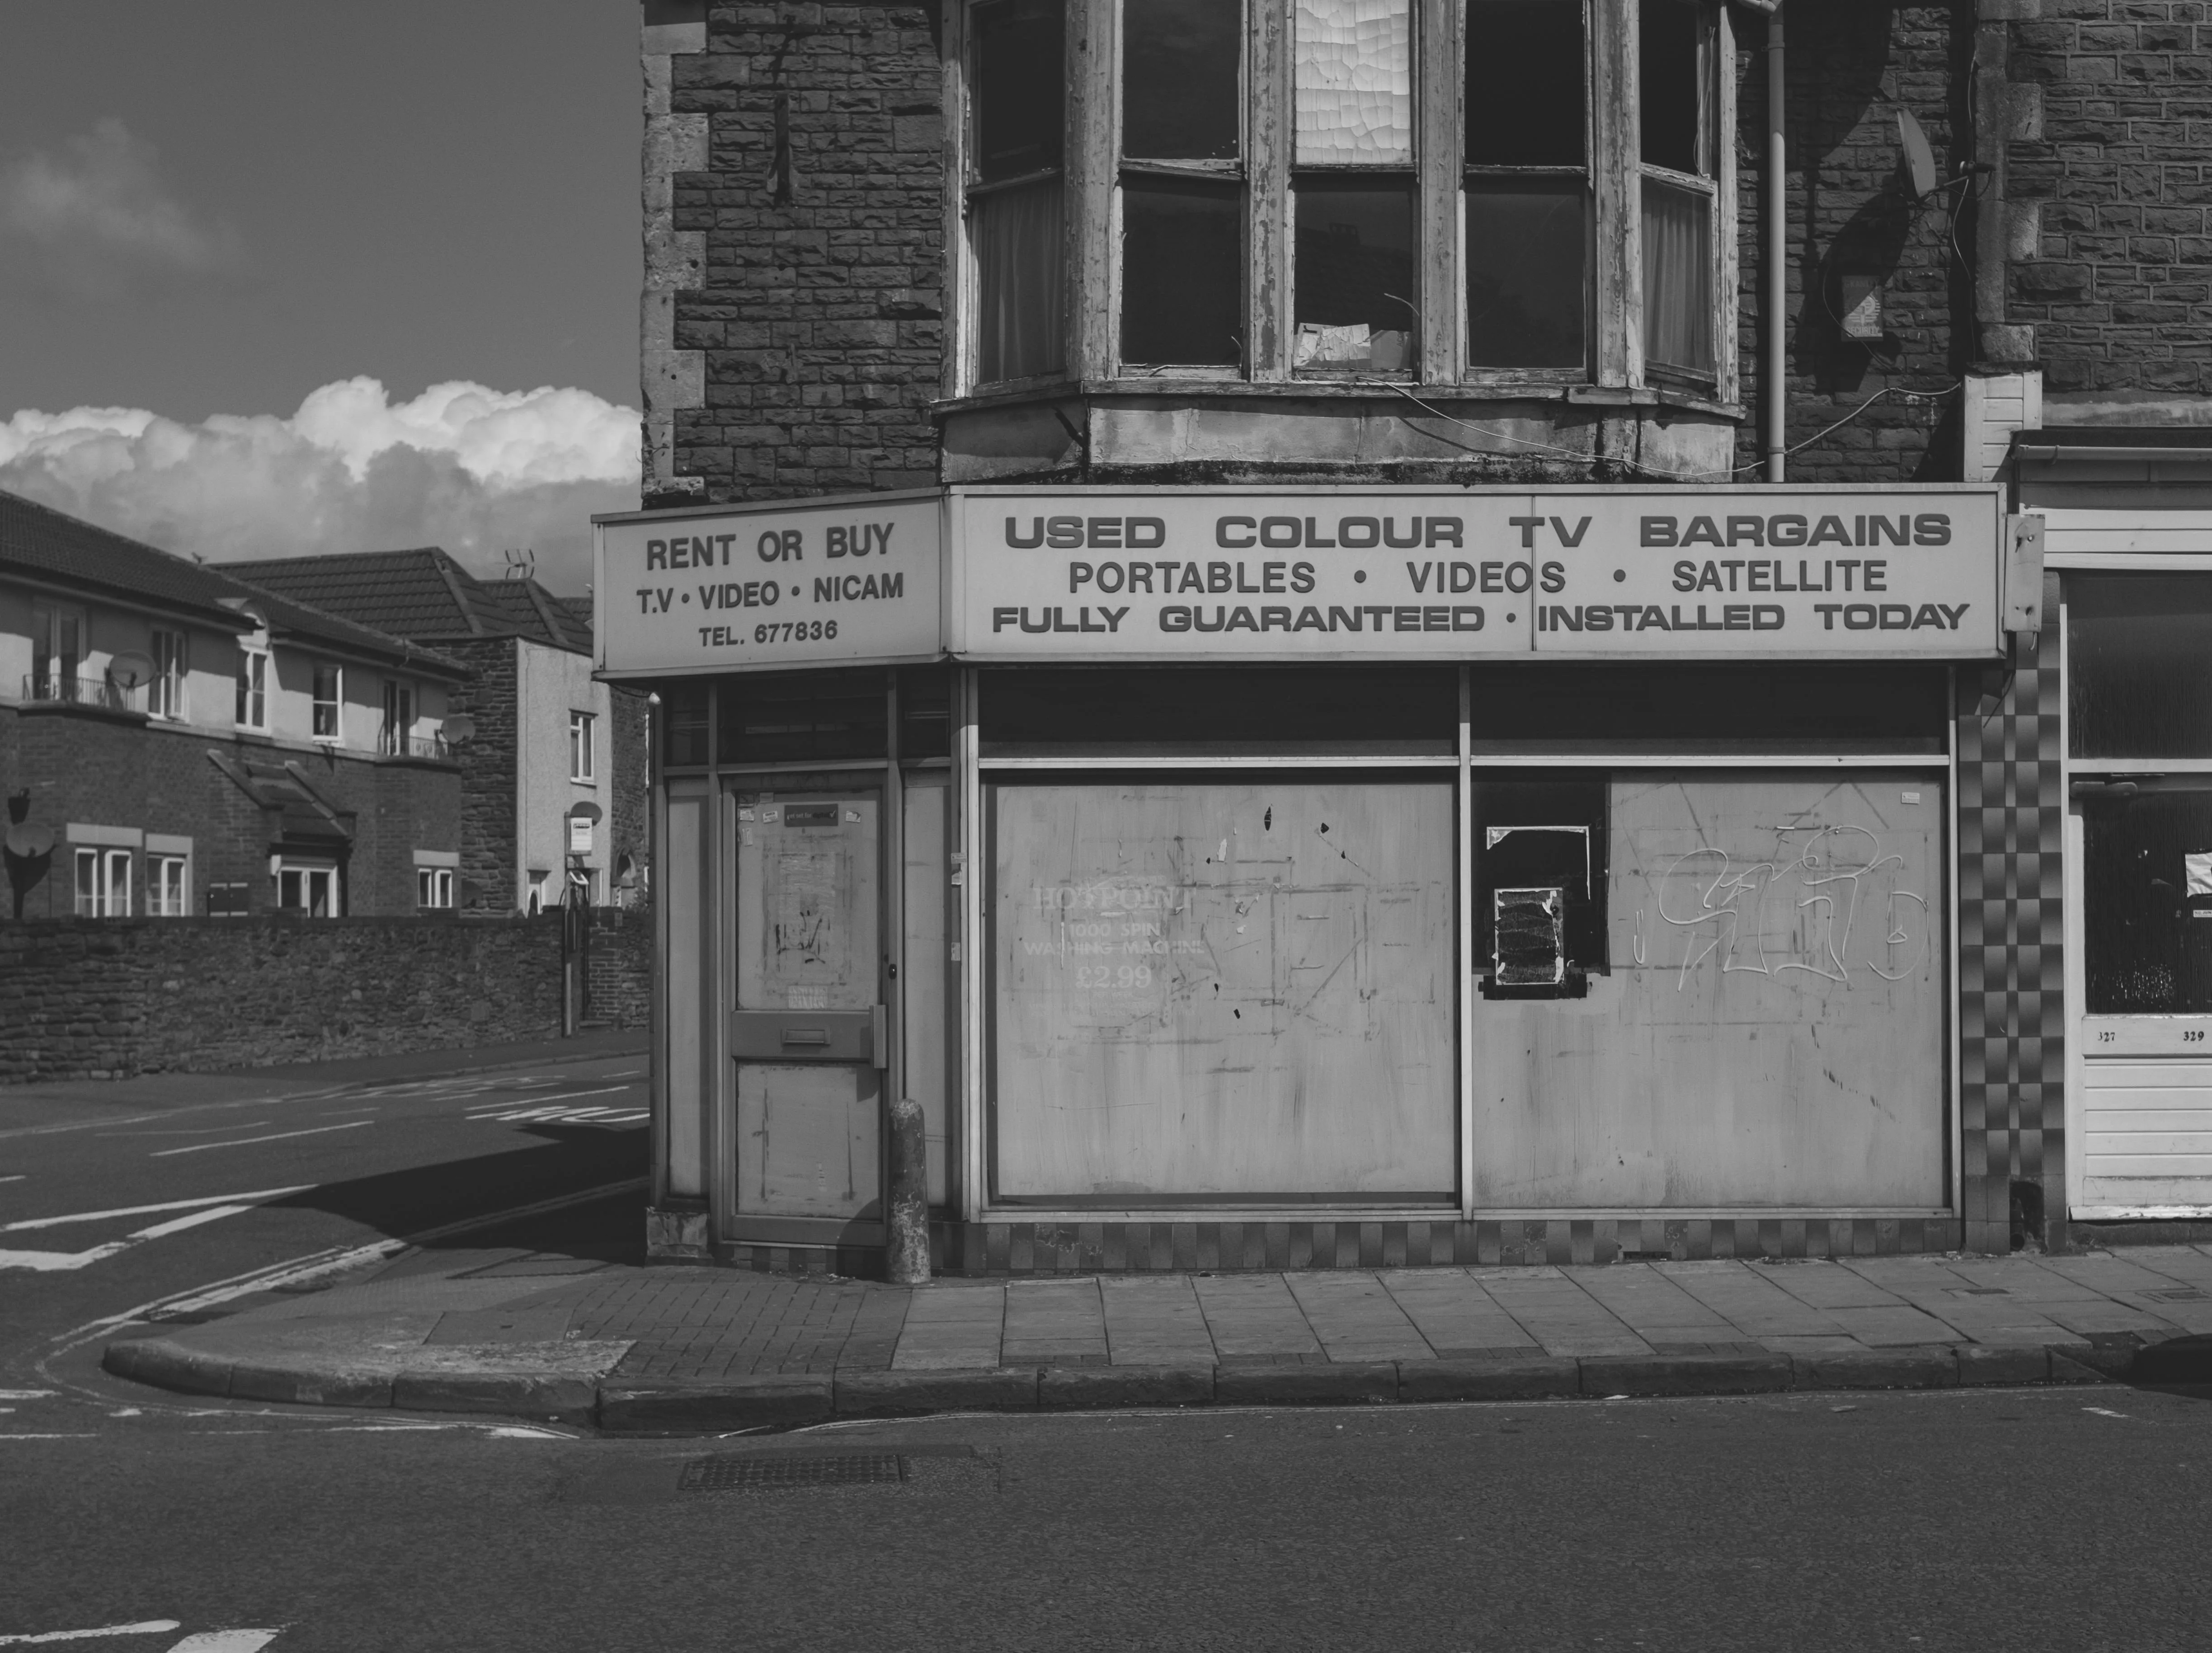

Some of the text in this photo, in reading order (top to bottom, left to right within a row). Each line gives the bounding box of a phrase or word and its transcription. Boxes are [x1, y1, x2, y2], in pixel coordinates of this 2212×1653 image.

[1006, 514, 1951, 549] USED COLOUR TV BARGAINS
[647, 523, 894, 570] RENT OR BUY
[1070, 560, 1887, 593] PORTABLES VIDEOS SATELLITE
[636, 573, 903, 614] T.V VIDEO NICAM
[993, 604, 1970, 633] FULLY GUARANTEED INSTALLED TODAY
[699, 620, 837, 647] TEL. 677836
[1069, 923, 1160, 937] 1000 SPIN
[1076, 966, 1152, 988] £2.99
[2098, 1032, 2115, 1042] 327
[2184, 1031, 2204, 1041] 329
